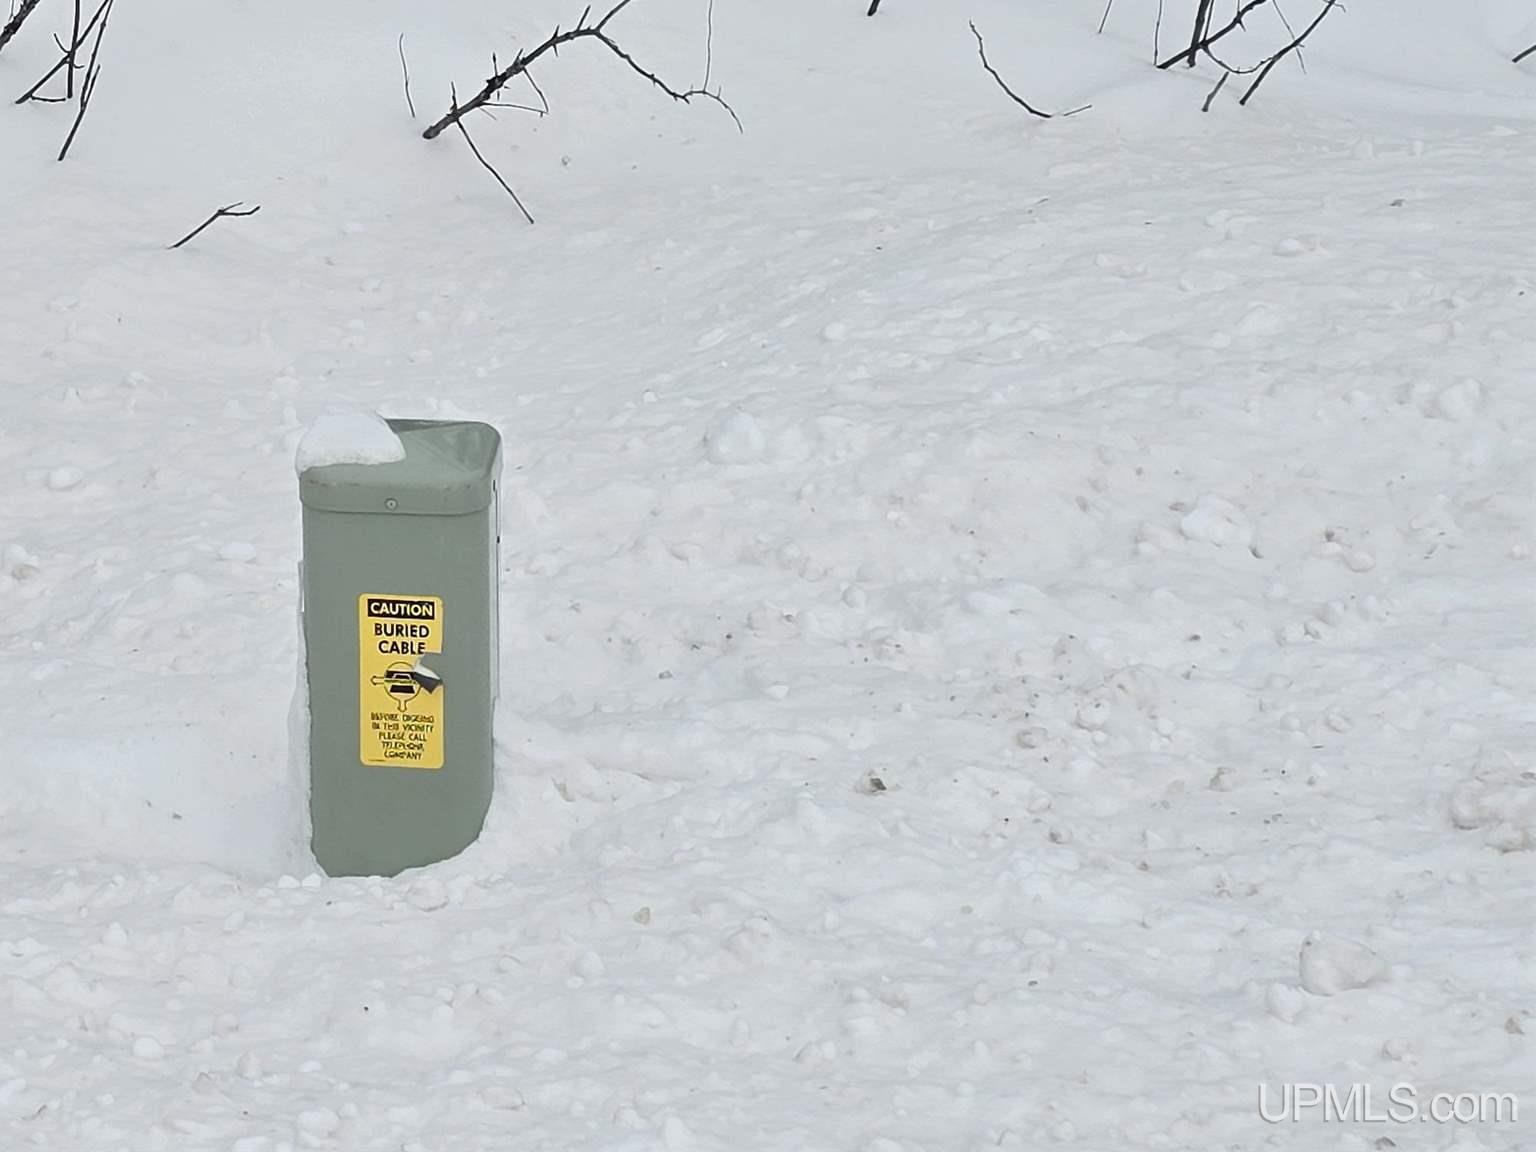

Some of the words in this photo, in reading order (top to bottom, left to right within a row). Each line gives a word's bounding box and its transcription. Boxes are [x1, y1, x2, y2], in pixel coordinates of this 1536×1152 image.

[370, 602, 433, 617] CAUTION
[374, 623, 430, 638] BURIED
[378, 640, 426, 655] CABLE
[379, 732, 405, 741] PLEASE
[408, 733, 427, 742] CALL
